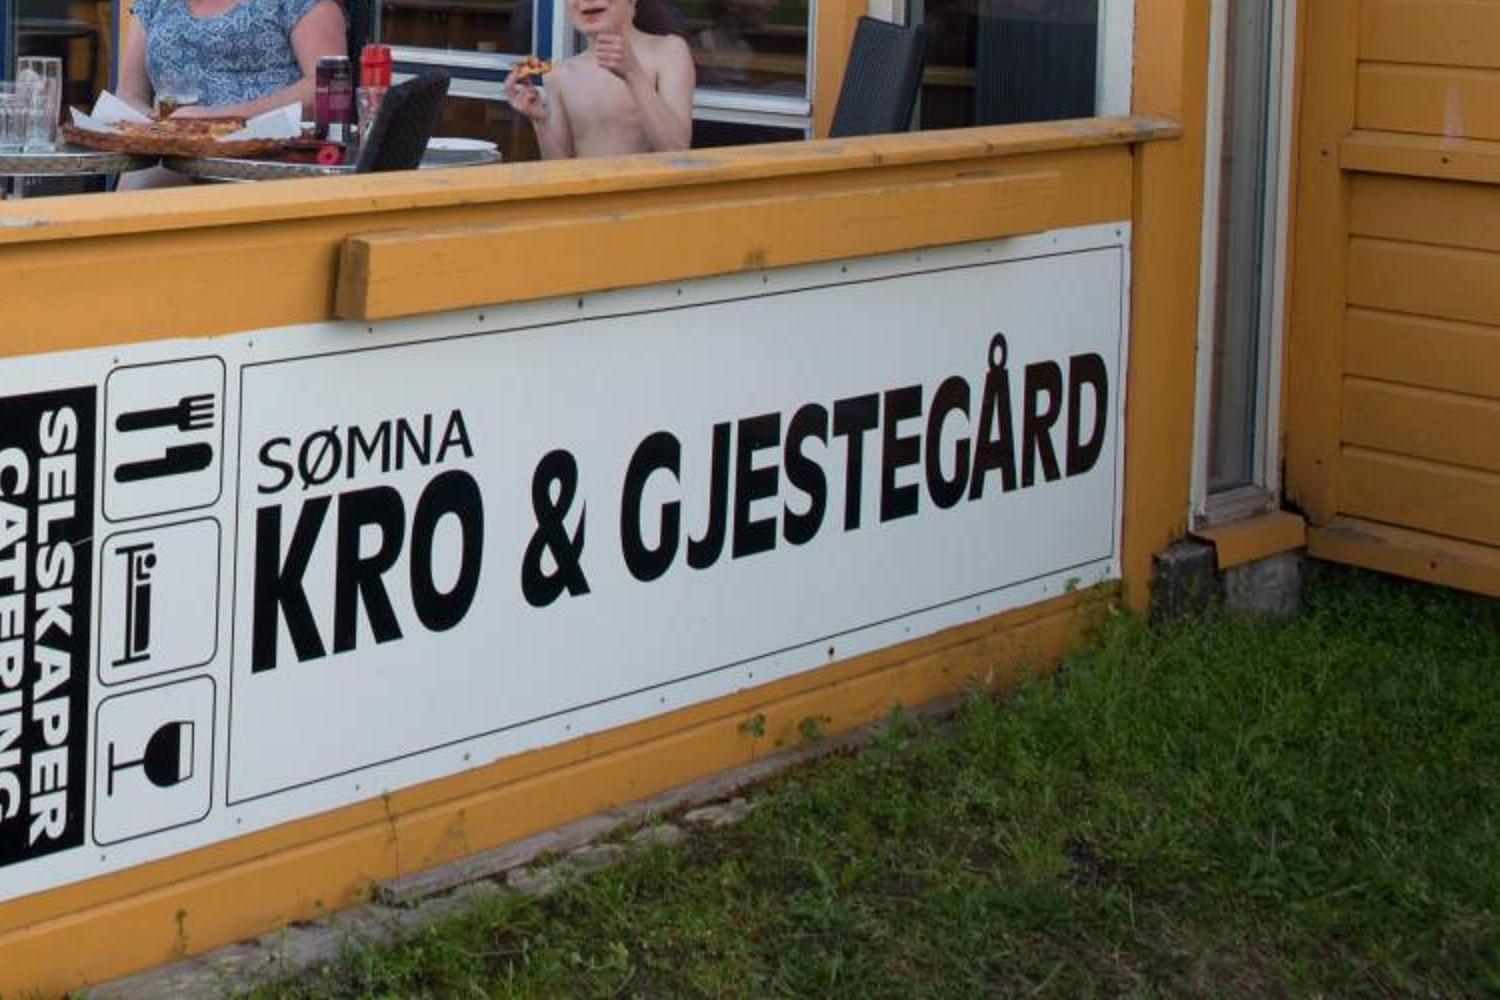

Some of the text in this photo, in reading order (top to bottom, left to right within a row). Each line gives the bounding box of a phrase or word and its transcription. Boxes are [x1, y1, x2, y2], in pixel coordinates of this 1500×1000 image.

[251, 332, 1109, 674] KRO & GJESTEGÅRD
[258, 410, 474, 495] SØMNA
[29, 406, 78, 846] SELSKAPER
